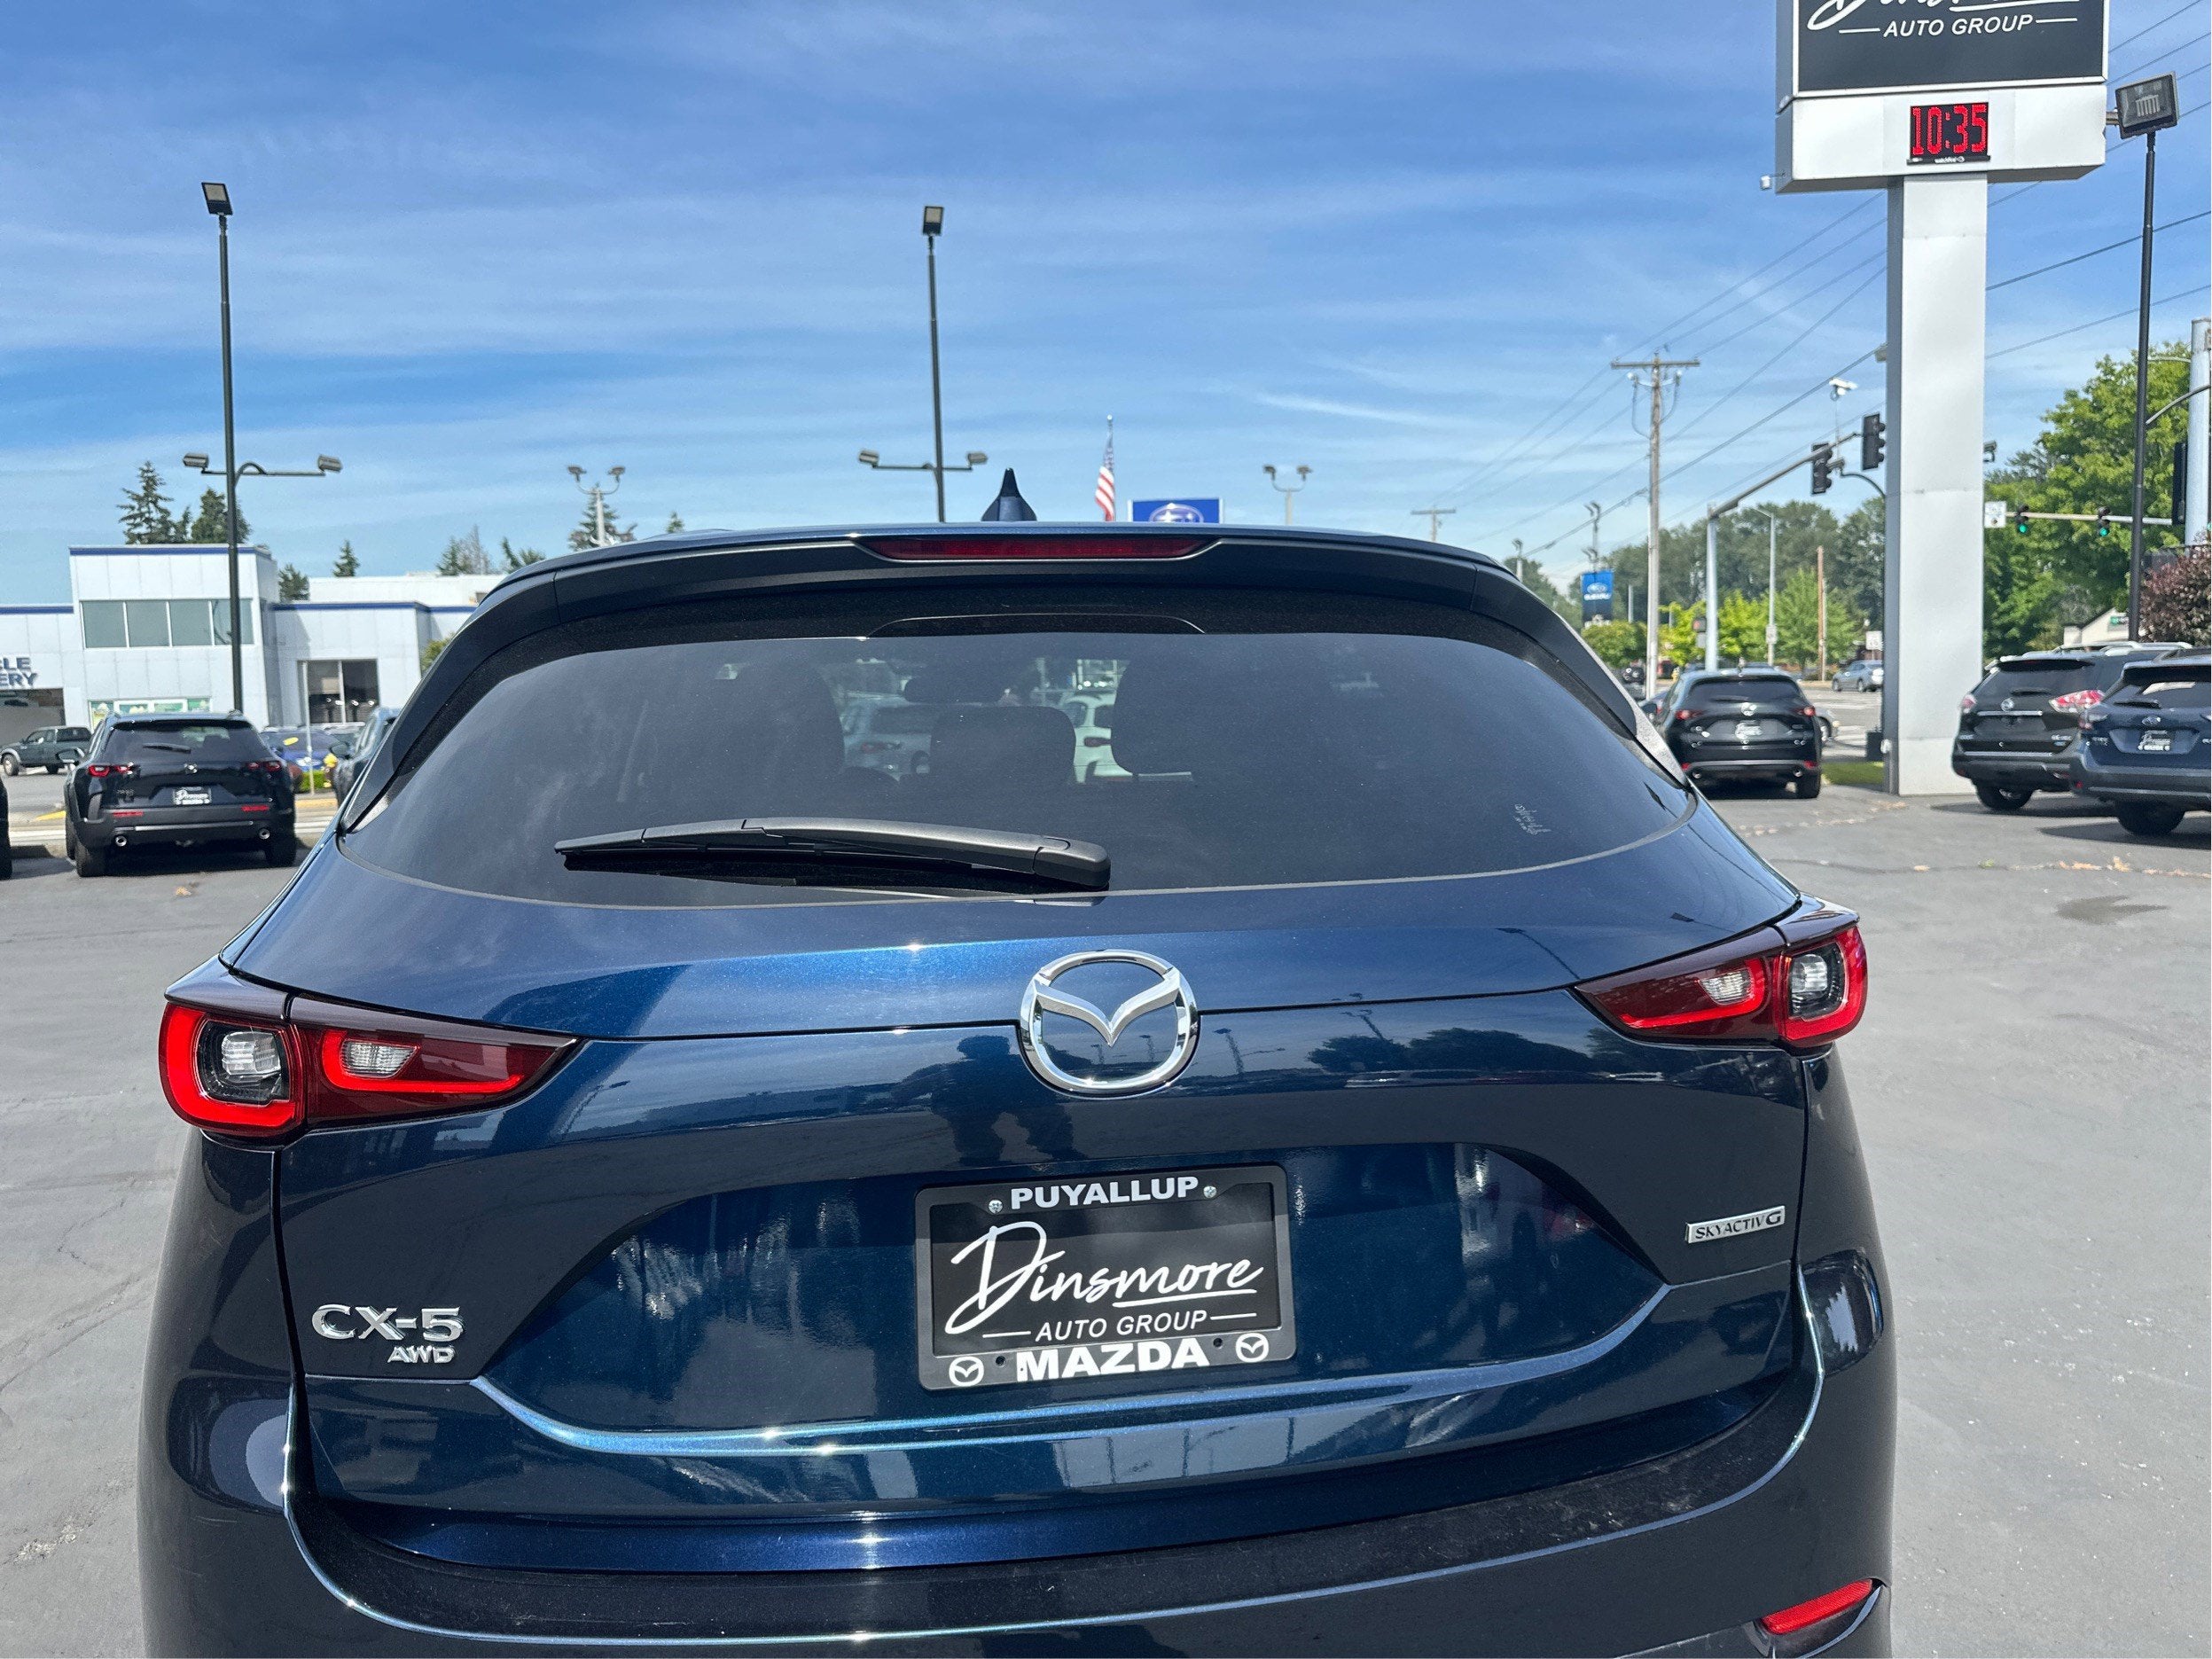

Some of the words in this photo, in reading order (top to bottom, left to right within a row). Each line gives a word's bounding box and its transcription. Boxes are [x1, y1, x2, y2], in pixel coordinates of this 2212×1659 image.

[1883, 20, 1944, 38] AUTO
[1951, 14, 2034, 35] GROUP
[1912, 104, 1987, 155] 10:35
[0, 657, 31, 670] LE
[1011, 1176, 1199, 1210] PUYALLUP
[945, 1220, 1264, 1334] Dinsmore
[311, 1303, 465, 1342] CX-5
[1035, 1317, 1107, 1342] AUTO
[1116, 1309, 1207, 1336] GROUP
[387, 1344, 457, 1364] AWD
[1015, 1337, 1210, 1383] MAZDA
